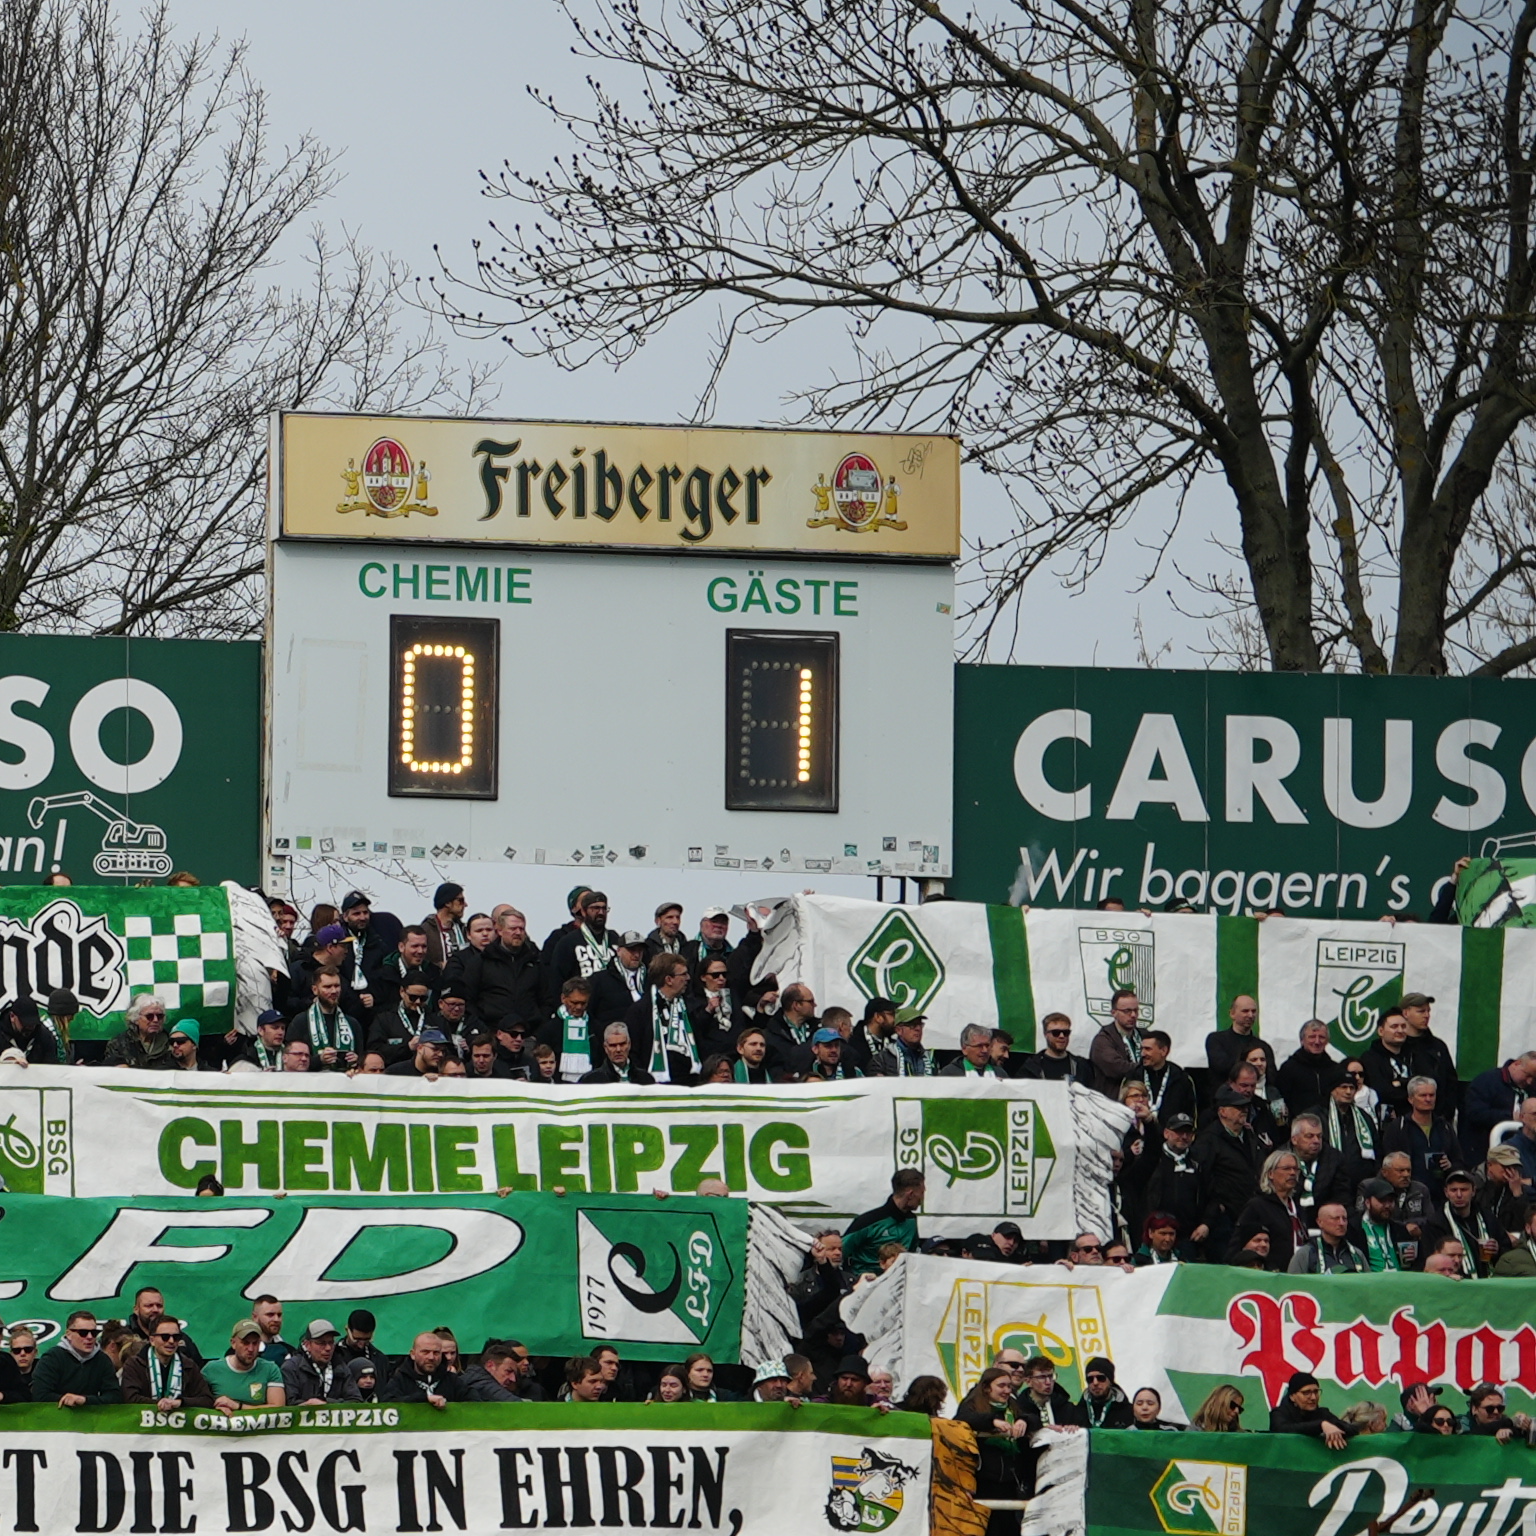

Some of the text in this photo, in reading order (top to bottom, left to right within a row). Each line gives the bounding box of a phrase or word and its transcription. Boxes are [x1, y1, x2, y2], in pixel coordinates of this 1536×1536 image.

[472, 437, 773, 541] Freiberger
[358, 562, 532, 604] CHEMIE
[706, 570, 859, 617] GÄSTE
[403, 643, 474, 775] 0
[799, 668, 813, 783] 1
[1013, 708, 1536, 832] CARUS
[1020, 846, 1123, 903] Wir
[1139, 842, 1410, 916] baggern's
[1096, 930, 1140, 942] BSG
[1325, 946, 1398, 964] LEIPZIG
[47, 1119, 68, 1177] BSG
[158, 1116, 812, 1193] CHEMIE LEIPZIG
[900, 1127, 919, 1171] SG
[1012, 1109, 1029, 1207] LEIPZIG
[587, 1275, 607, 1333] 1977
[1077, 1317, 1102, 1362] BS
[140, 1409, 400, 1431] BSG CHEMIE LEIPZIG
[76, 1450, 197, 1534] DIE
[223, 1449, 368, 1534] BSG
[395, 1447, 466, 1532] IN
[1228, 1471, 1241, 1532] LEIPZIG
